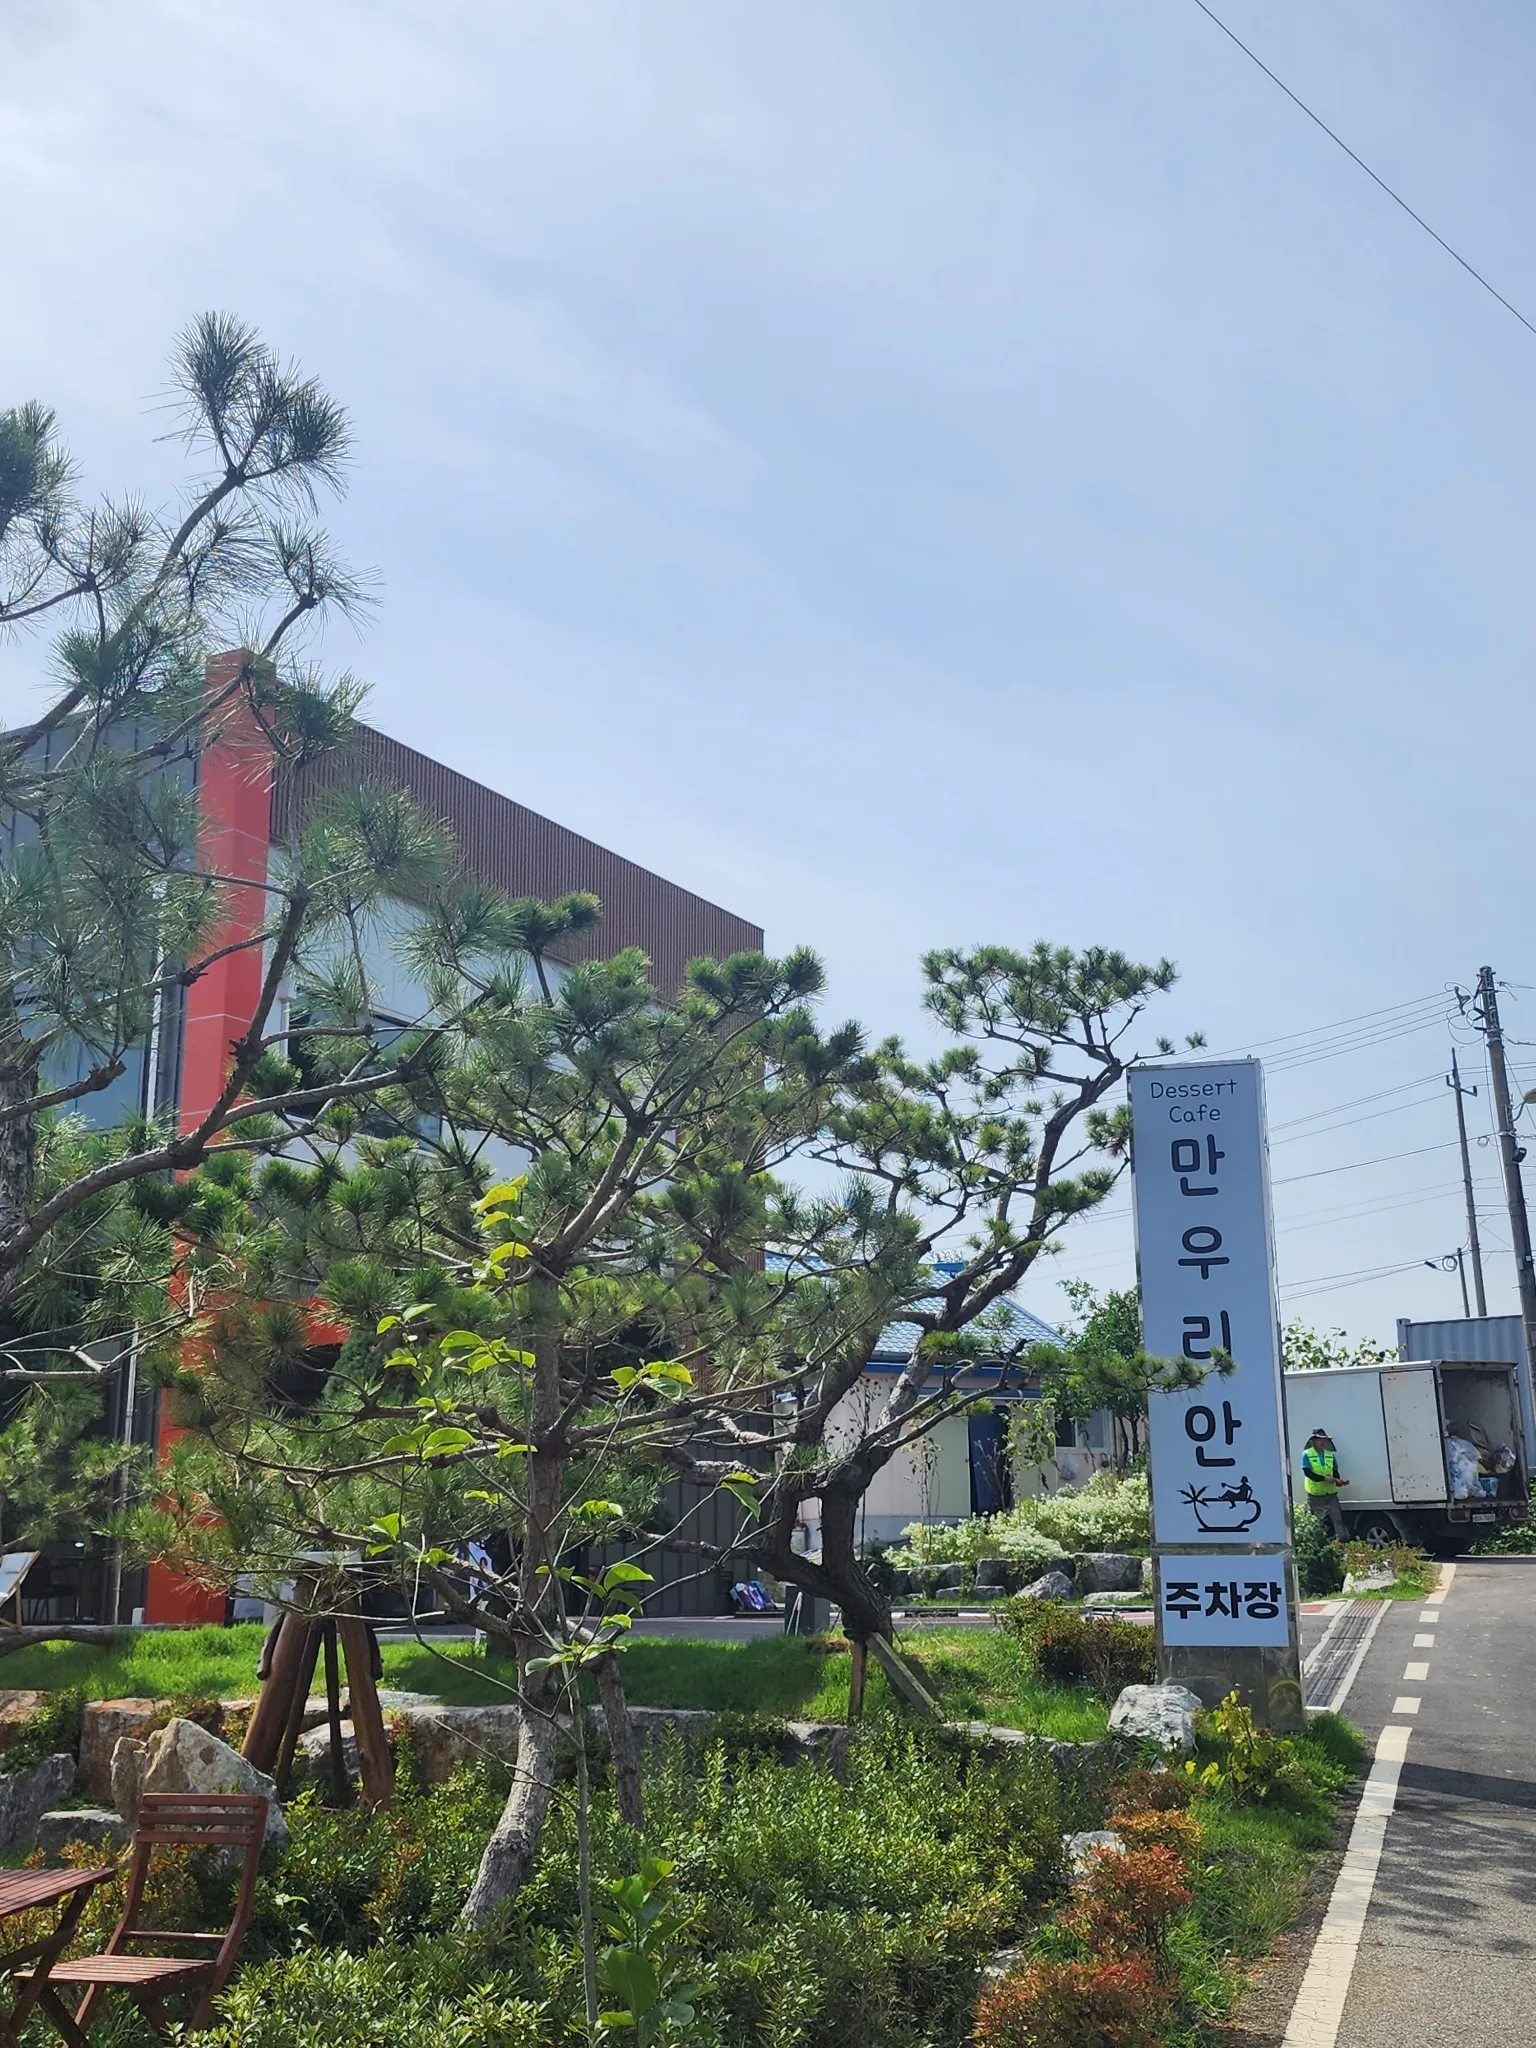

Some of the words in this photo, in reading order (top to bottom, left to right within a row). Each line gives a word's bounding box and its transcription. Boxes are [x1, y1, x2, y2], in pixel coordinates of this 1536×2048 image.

[1150, 1079, 1237, 1099] Dessert
[1169, 1103, 1221, 1123] Cafe
[1171, 1134, 1242, 1467] 만우리안
[1165, 1581, 1282, 1619] 주차장
